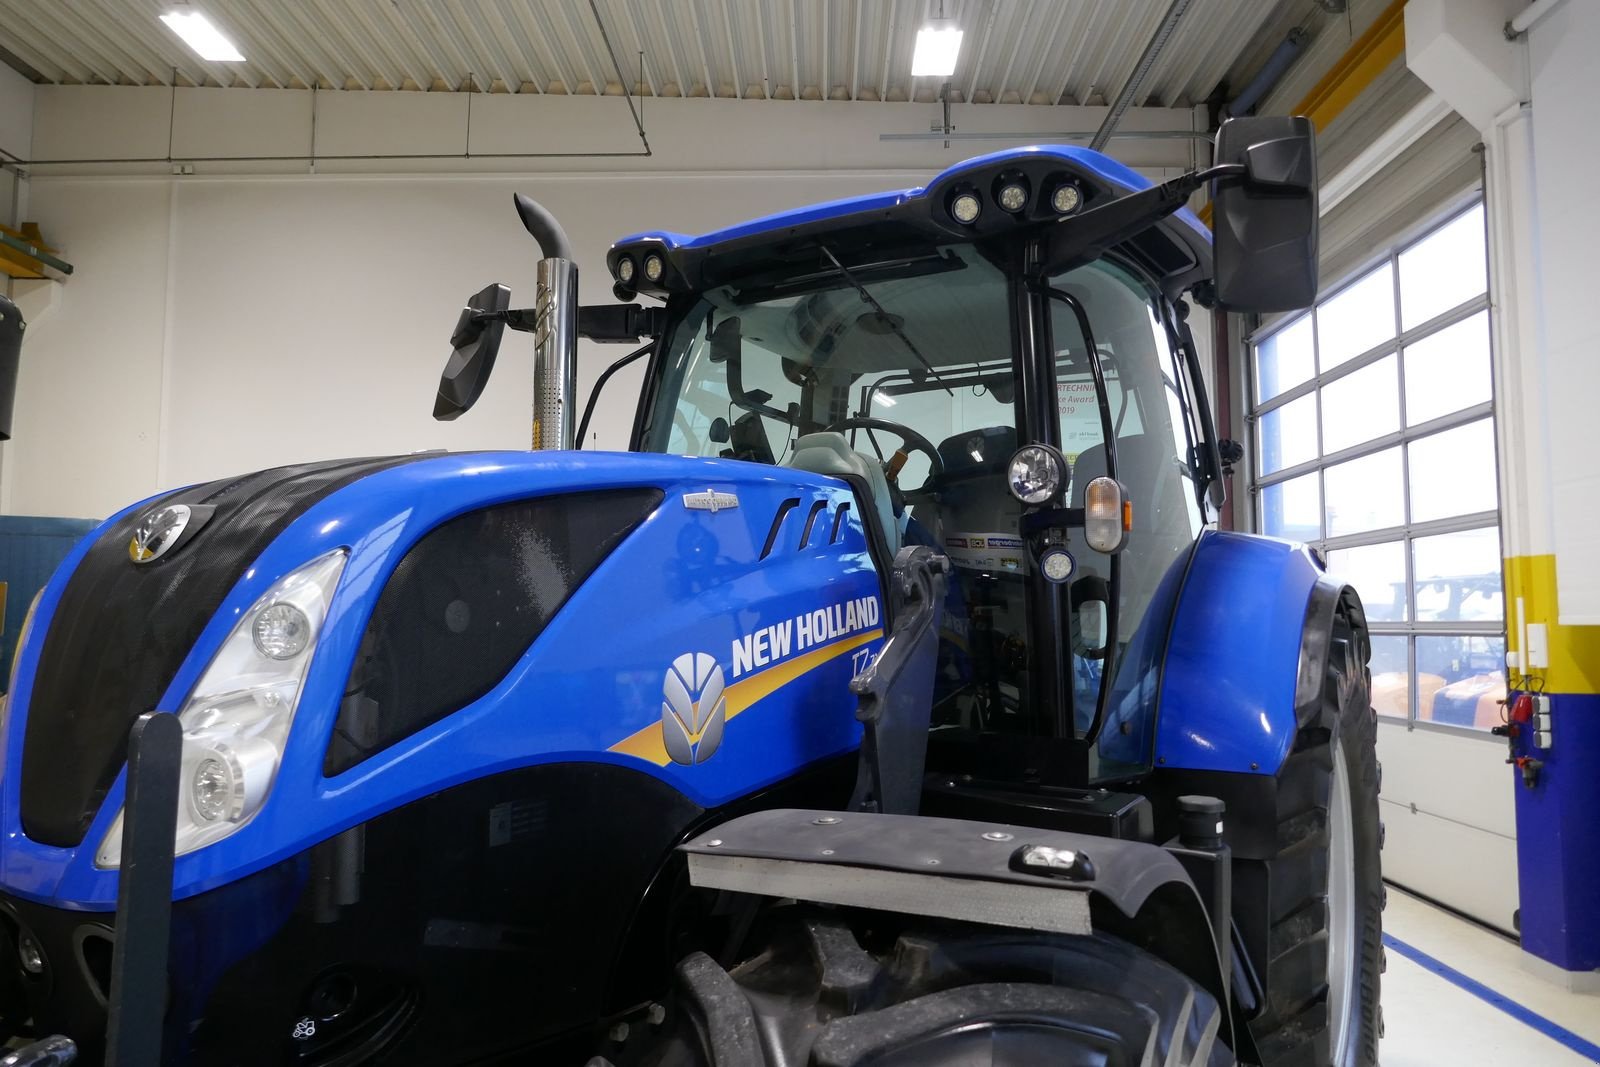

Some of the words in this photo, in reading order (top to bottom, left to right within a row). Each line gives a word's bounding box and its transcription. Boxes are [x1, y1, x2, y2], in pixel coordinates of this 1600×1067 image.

[1057, 384, 1096, 392] RTECHNI
[1067, 395, 1095, 403] Award
[732, 620, 792, 678] NEW
[796, 595, 879, 650] HOLLAND
